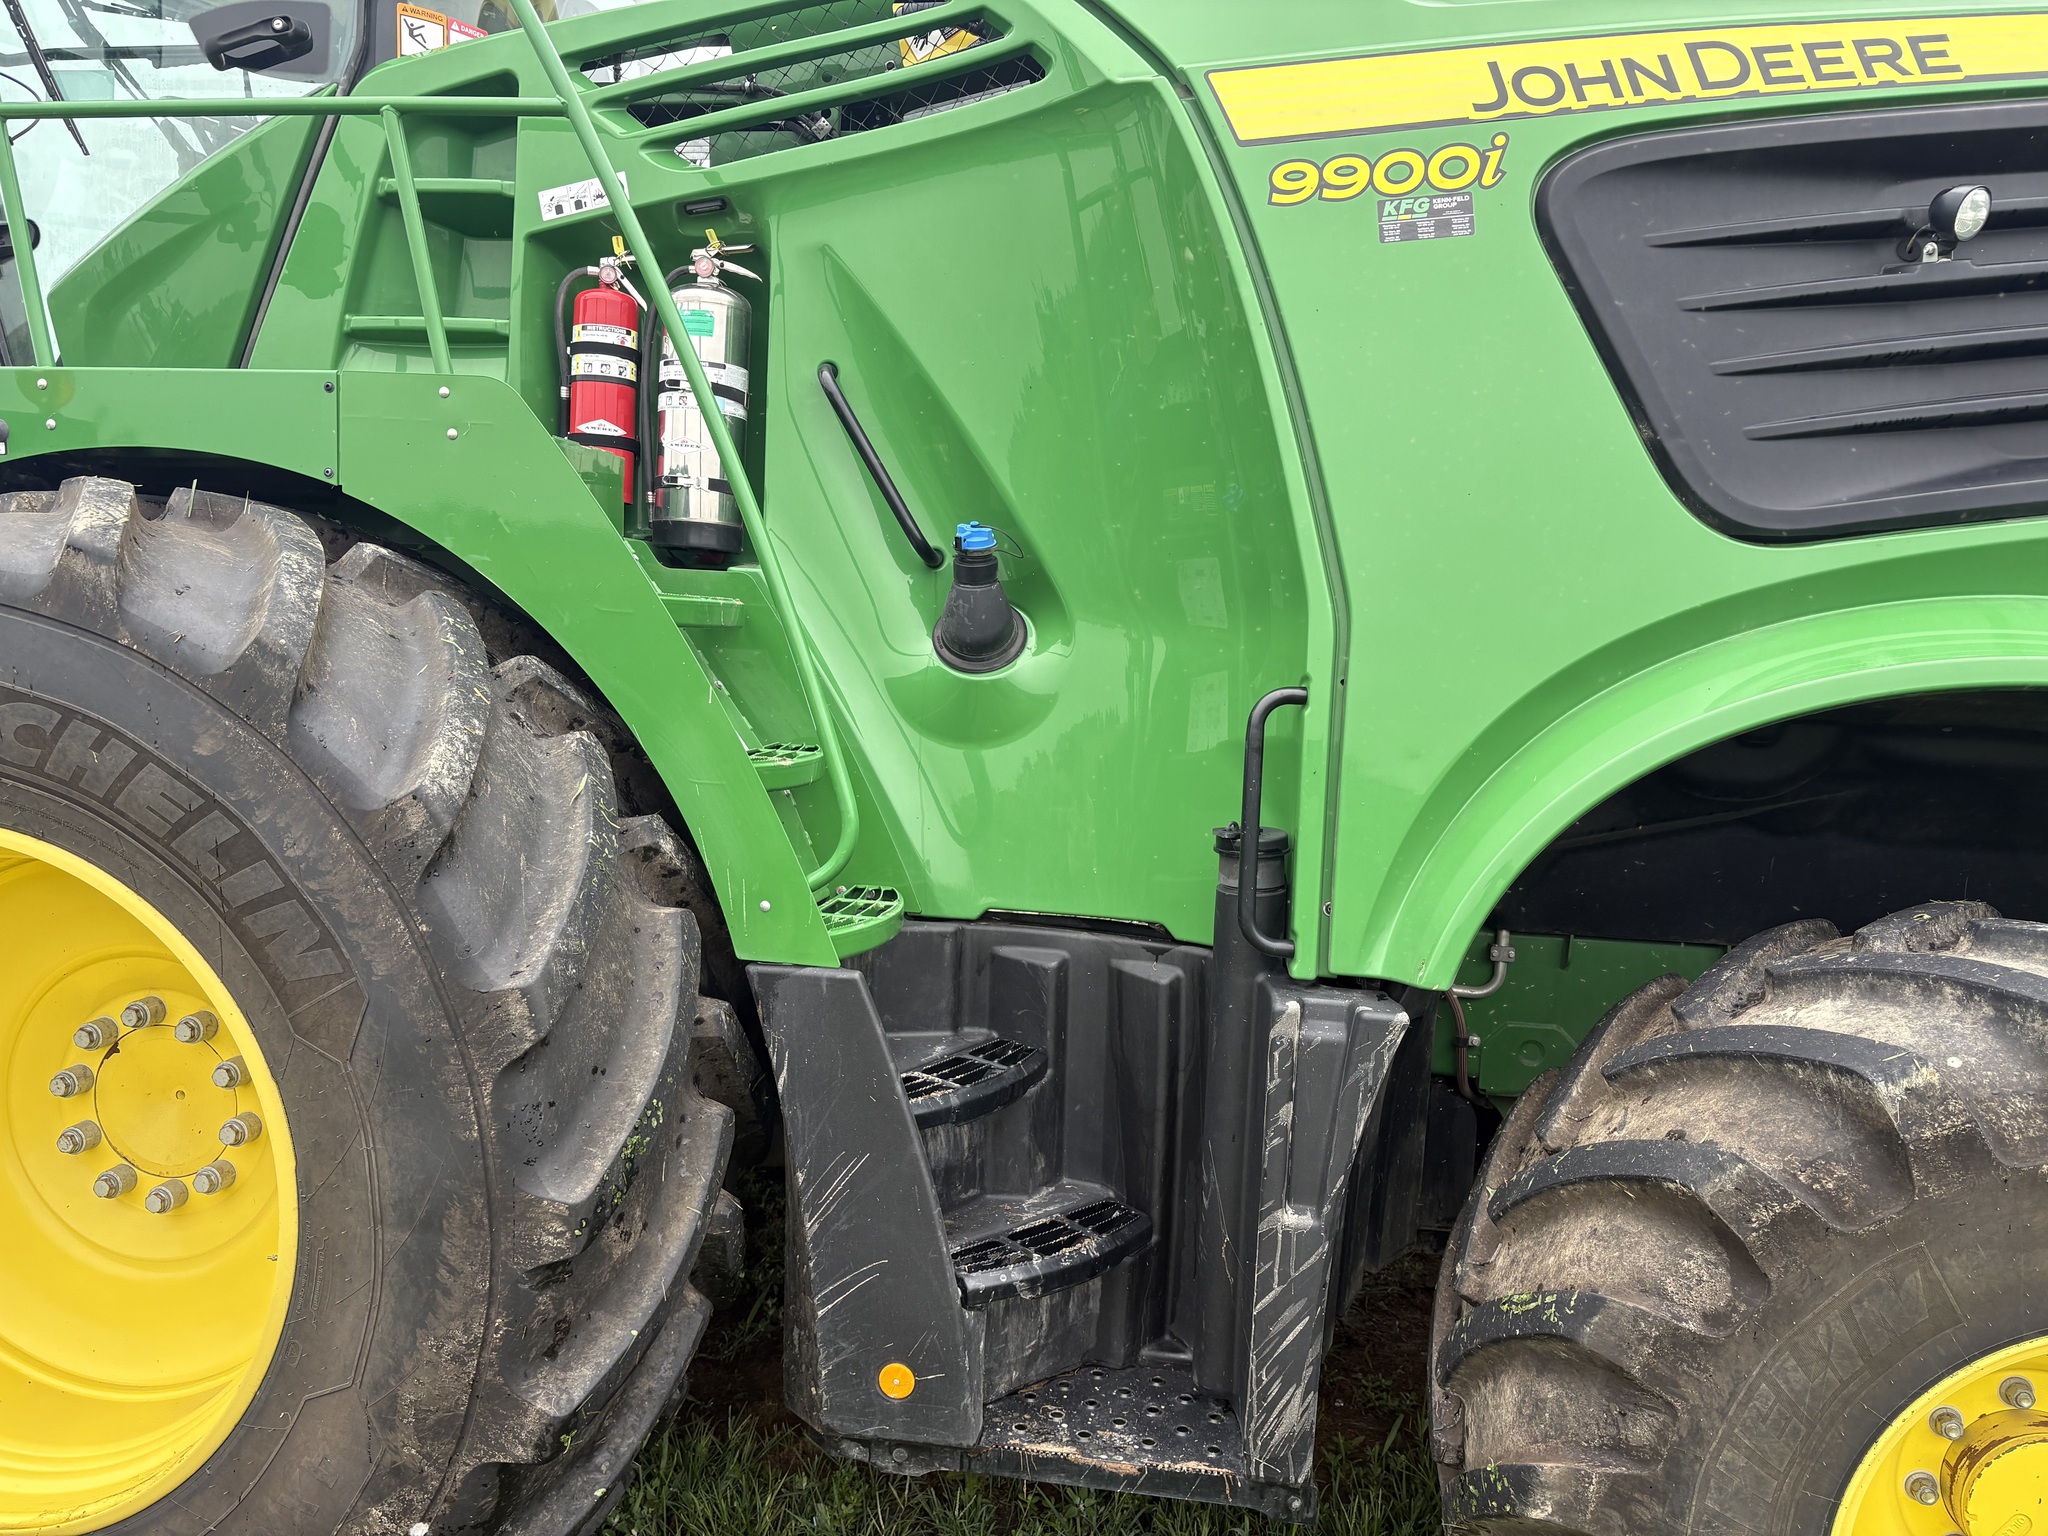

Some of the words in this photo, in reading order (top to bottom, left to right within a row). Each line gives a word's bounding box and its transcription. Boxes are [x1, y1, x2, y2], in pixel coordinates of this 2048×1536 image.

[409, 7, 443, 22] WARNING
[1472, 54, 1681, 112] JOHN
[1684, 33, 1963, 91] DEERE
[1267, 131, 1509, 205] 9900i
[1382, 197, 1430, 217] KFG
